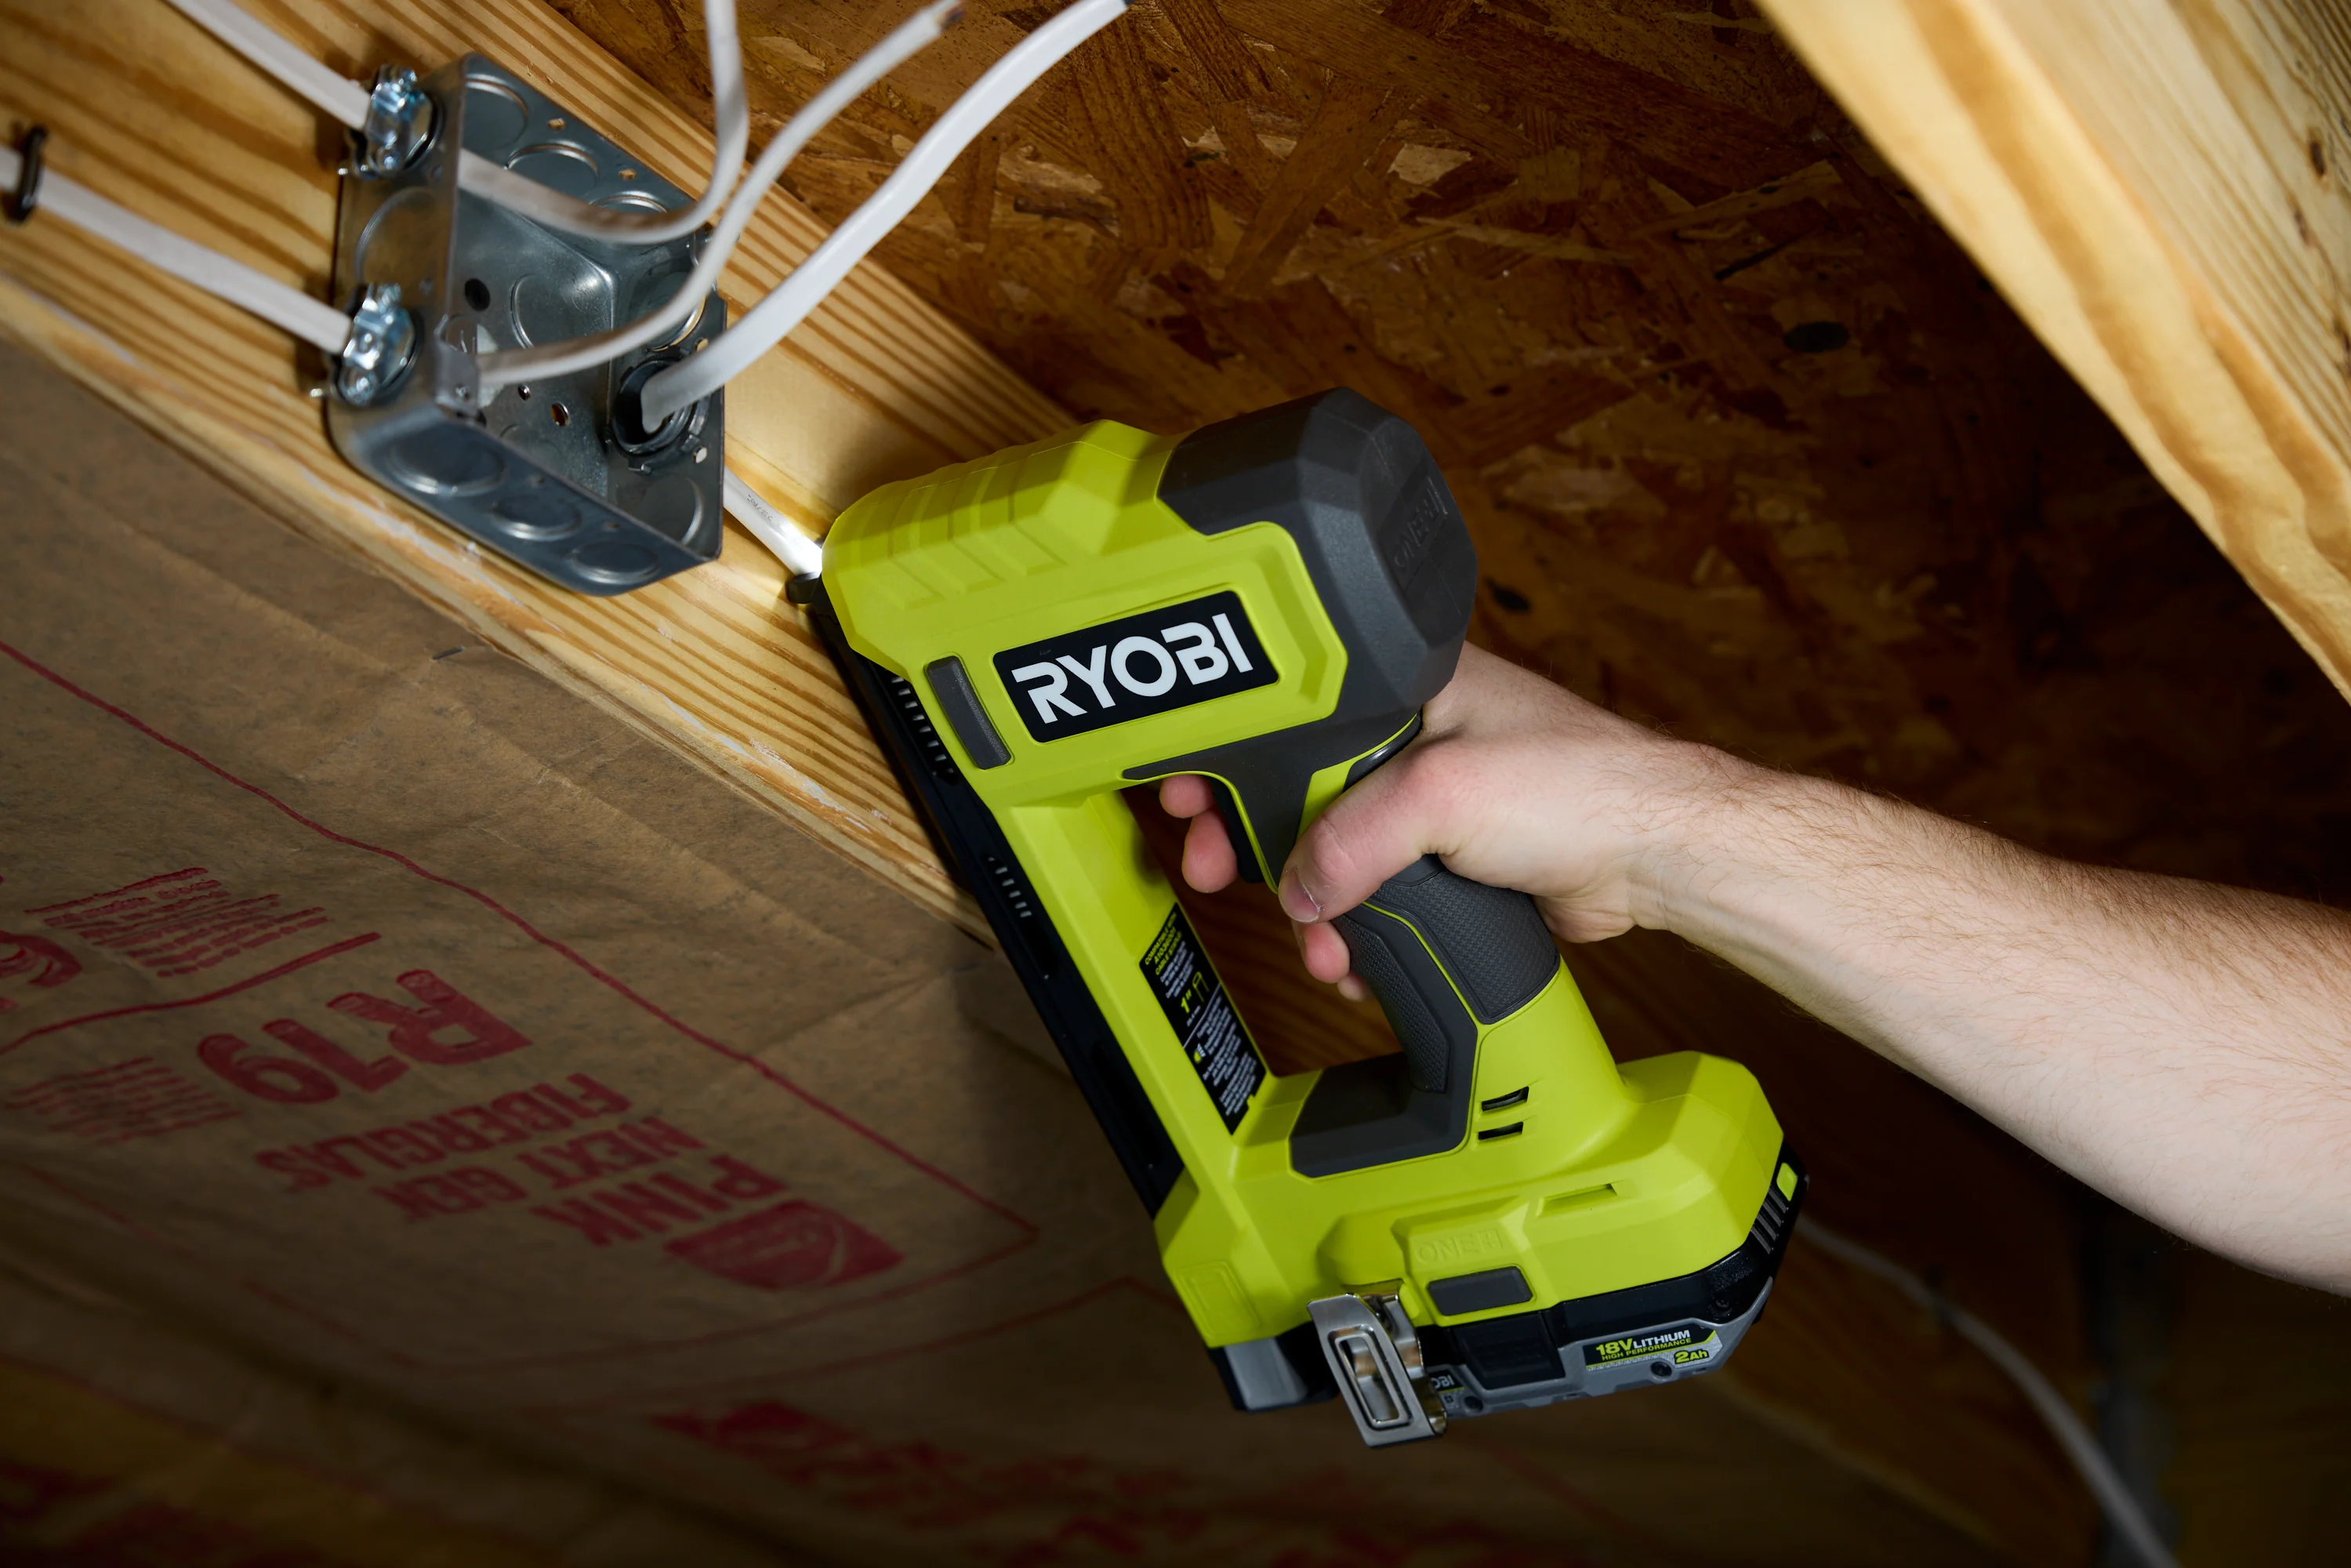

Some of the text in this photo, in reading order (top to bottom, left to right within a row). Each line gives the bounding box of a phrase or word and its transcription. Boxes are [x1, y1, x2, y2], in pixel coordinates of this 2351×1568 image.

[1010, 612, 1254, 724] RYOBI
[197, 968, 534, 1105] R19
[515, 1116, 705, 1189] NEXT
[528, 1154, 789, 1247] PINK
[1595, 1330, 1691, 1356] 18V LITHIUM
[1602, 1337, 1692, 1361] HIGH PERFORMANCE
[1674, 1349, 1709, 1363] 2Ah
[1431, 1374, 1455, 1388] OBI
